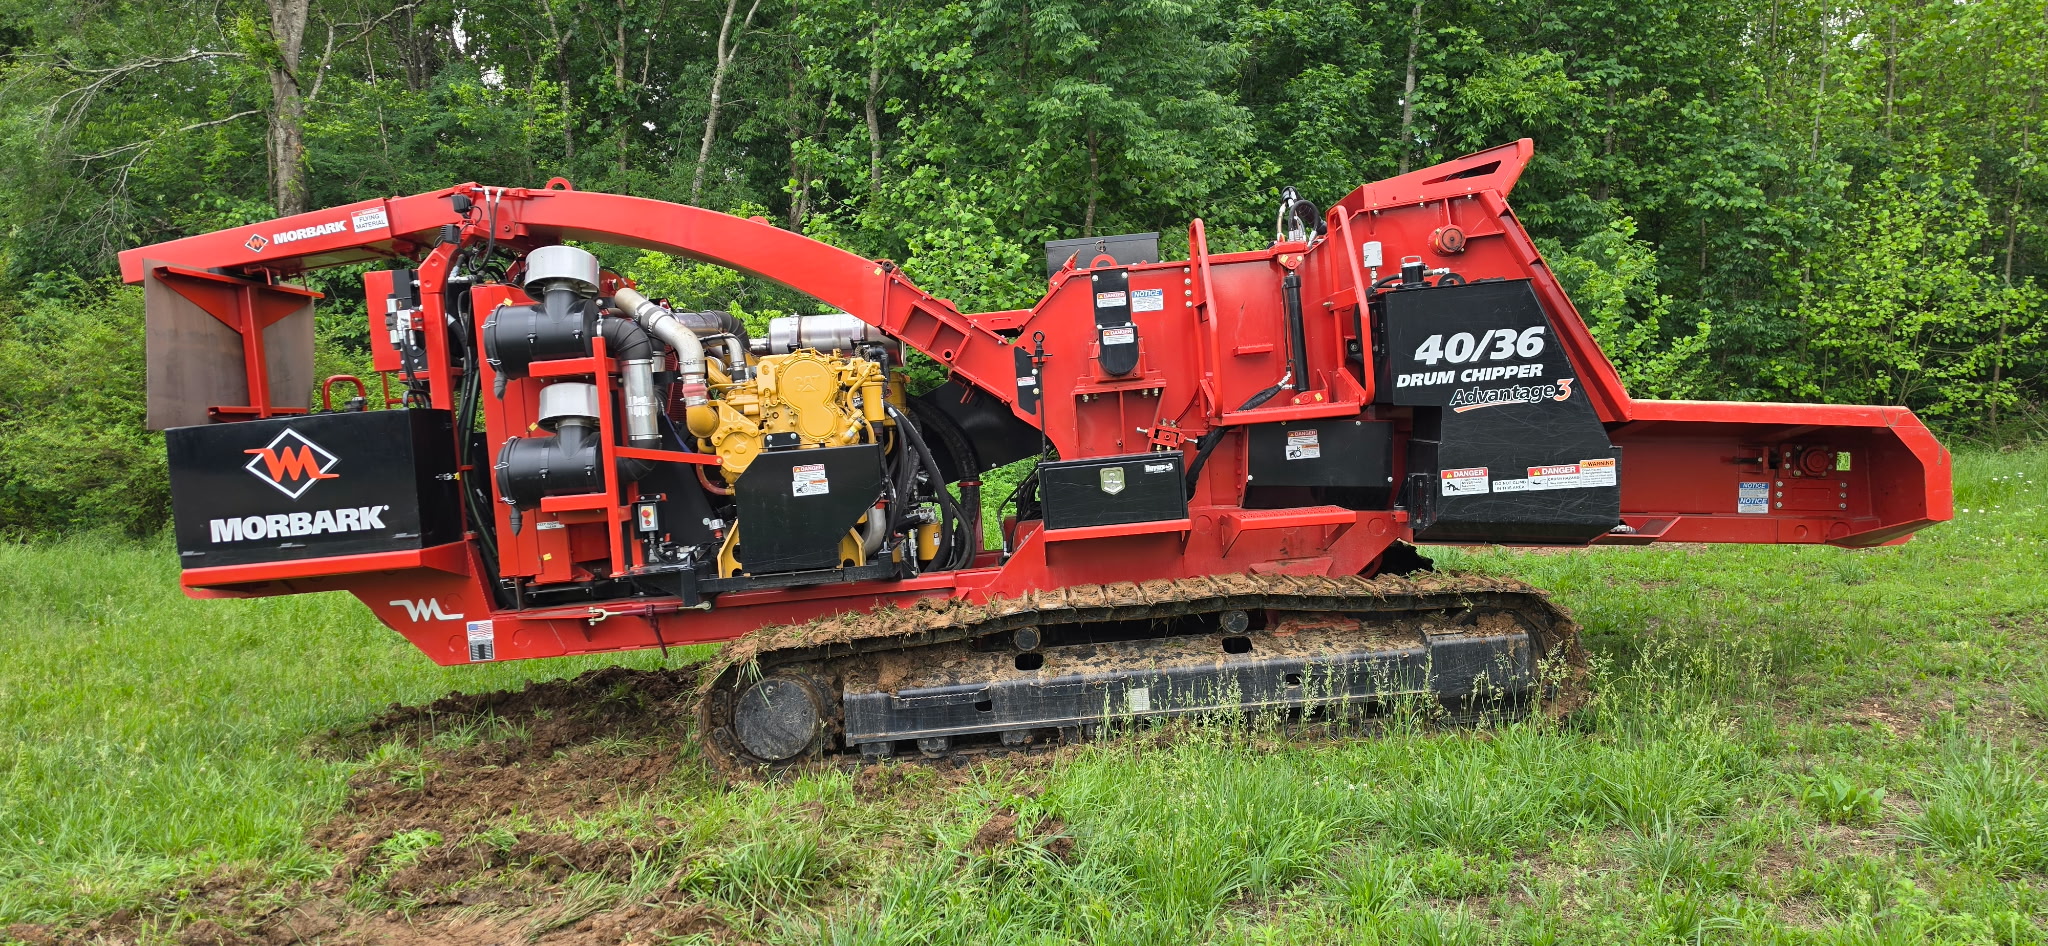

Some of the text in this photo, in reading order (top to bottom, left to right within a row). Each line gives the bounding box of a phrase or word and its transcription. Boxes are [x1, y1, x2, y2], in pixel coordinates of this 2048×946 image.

[359, 214, 380, 222] FLYING
[356, 220, 386, 229] MATERIAL
[273, 221, 347, 245] MORBARK
[1134, 290, 1160, 298] NOTICE
[1414, 326, 1546, 365] 40/36
[1396, 364, 1544, 388] DRUM CHIPPER
[1453, 469, 1484, 478] DANGER
[1541, 466, 1576, 475] DANGER
[210, 505, 387, 543] MORBARK
